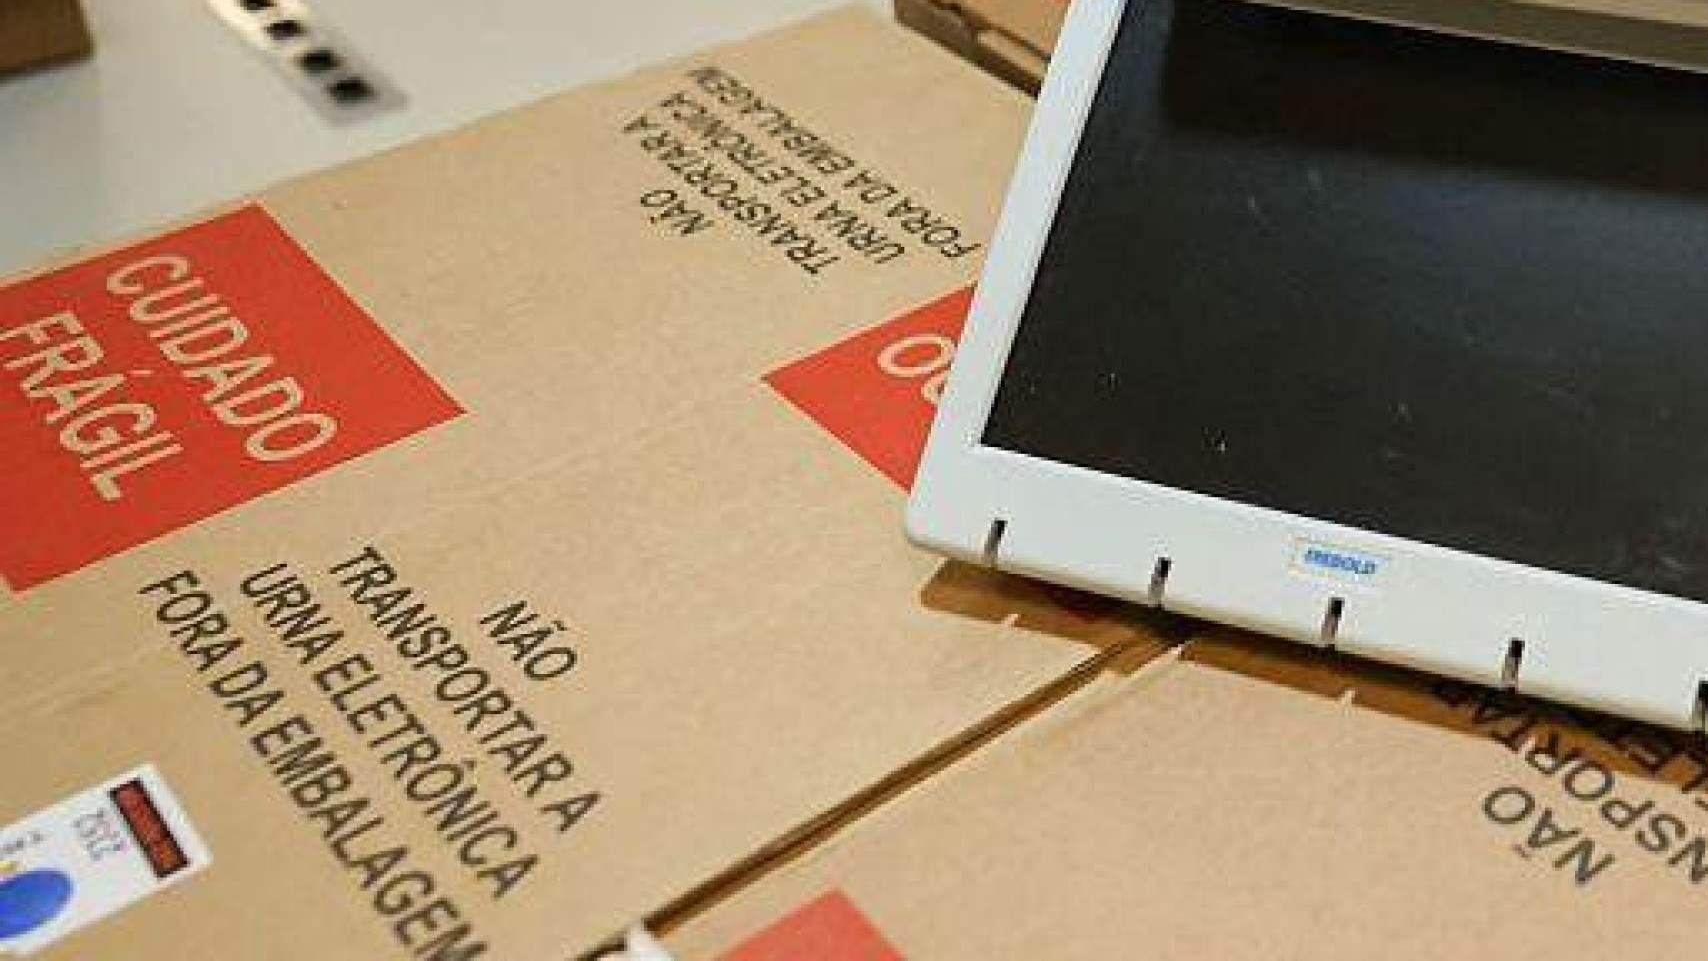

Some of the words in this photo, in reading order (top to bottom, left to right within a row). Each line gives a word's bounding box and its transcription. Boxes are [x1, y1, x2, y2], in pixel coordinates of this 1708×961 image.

[640, 135, 839, 275] TRANSPORTAR
[640, 188, 715, 237] NÃO
[814, 198, 906, 265] URNA
[845, 170, 898, 204] DA
[887, 195, 981, 259] FORA
[0, 310, 184, 501] FRÁGIL
[105, 256, 338, 462] CUIDADO
[329, 545, 574, 798] TRANSPORTAR
[541, 790, 604, 835] A
[480, 600, 578, 682] NÃO
[138, 570, 240, 677] FORA
[207, 664, 272, 730] DA
[252, 706, 492, 961] EMBALAGEM
[240, 562, 334, 666] URNA
[313, 653, 541, 900] ELETRÔNICA
[1482, 785, 1615, 886] NÃO
